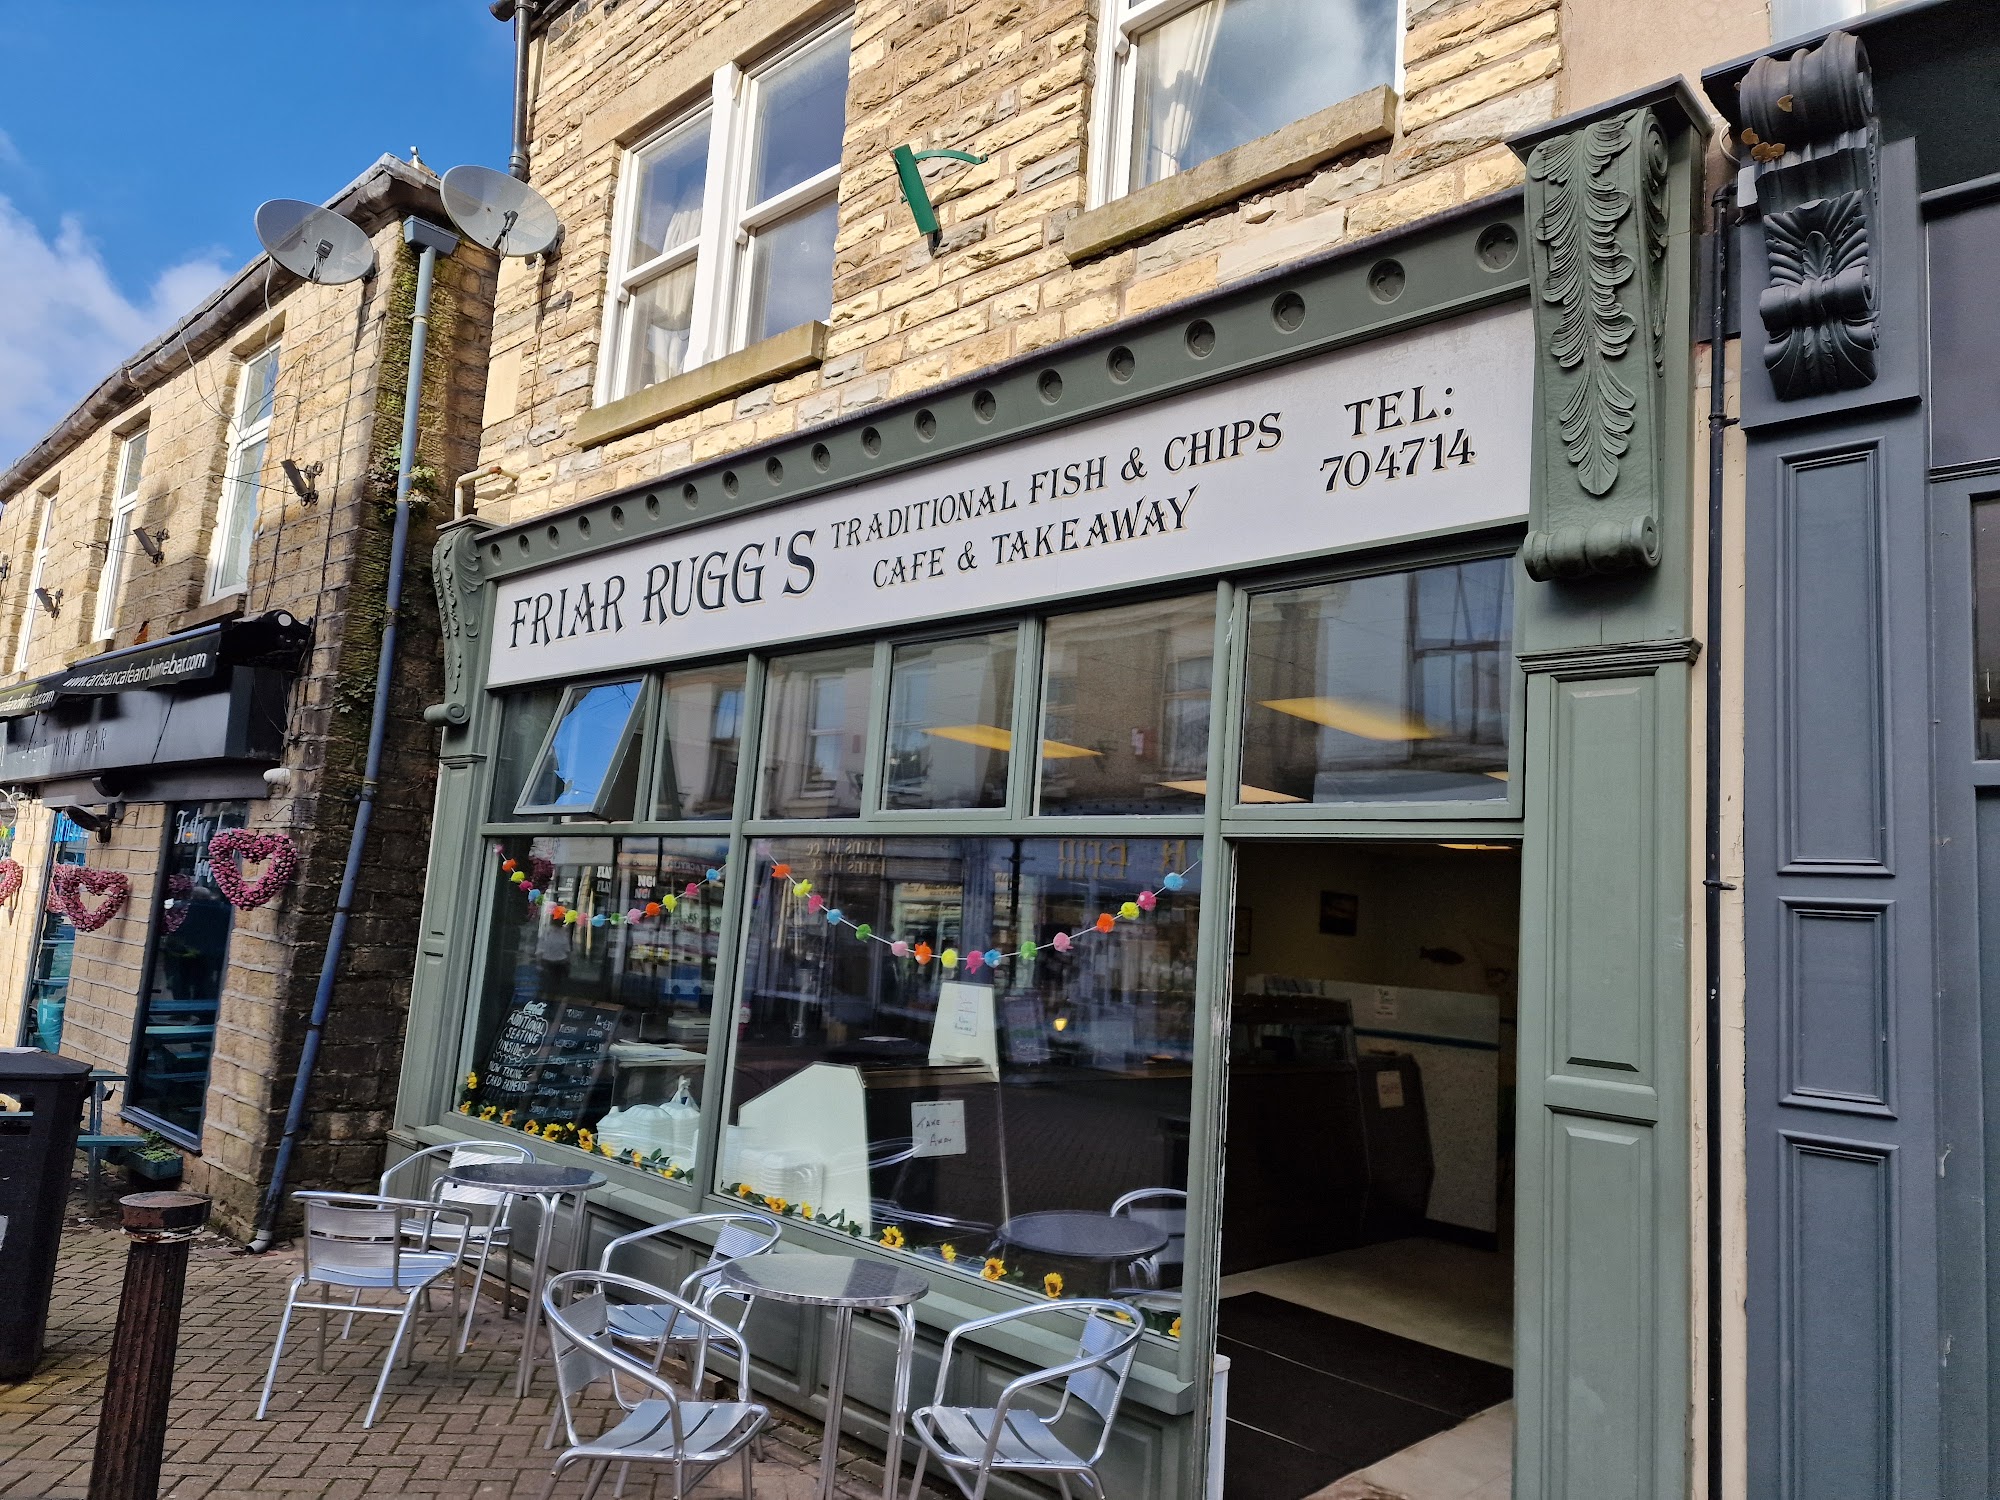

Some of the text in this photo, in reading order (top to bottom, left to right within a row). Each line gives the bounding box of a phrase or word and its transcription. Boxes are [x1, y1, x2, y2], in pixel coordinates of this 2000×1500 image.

[1344, 385, 1454, 437] TEL:
[831, 411, 1283, 549] TRADITIONAL FISH & CHIPS
[1319, 428, 1475, 492] 704714
[873, 484, 1200, 588] CAFE & TAKEAWAY
[509, 529, 817, 649] FRIAR RUGG'S
[53, 731, 79, 756] WINE
[84, 727, 107, 753] BAR
[498, 1039, 526, 1056] INSIDE
[505, 1027, 540, 1044] SEATING
[485, 1074, 502, 1087] CARD
[488, 1060, 501, 1072] NOW
